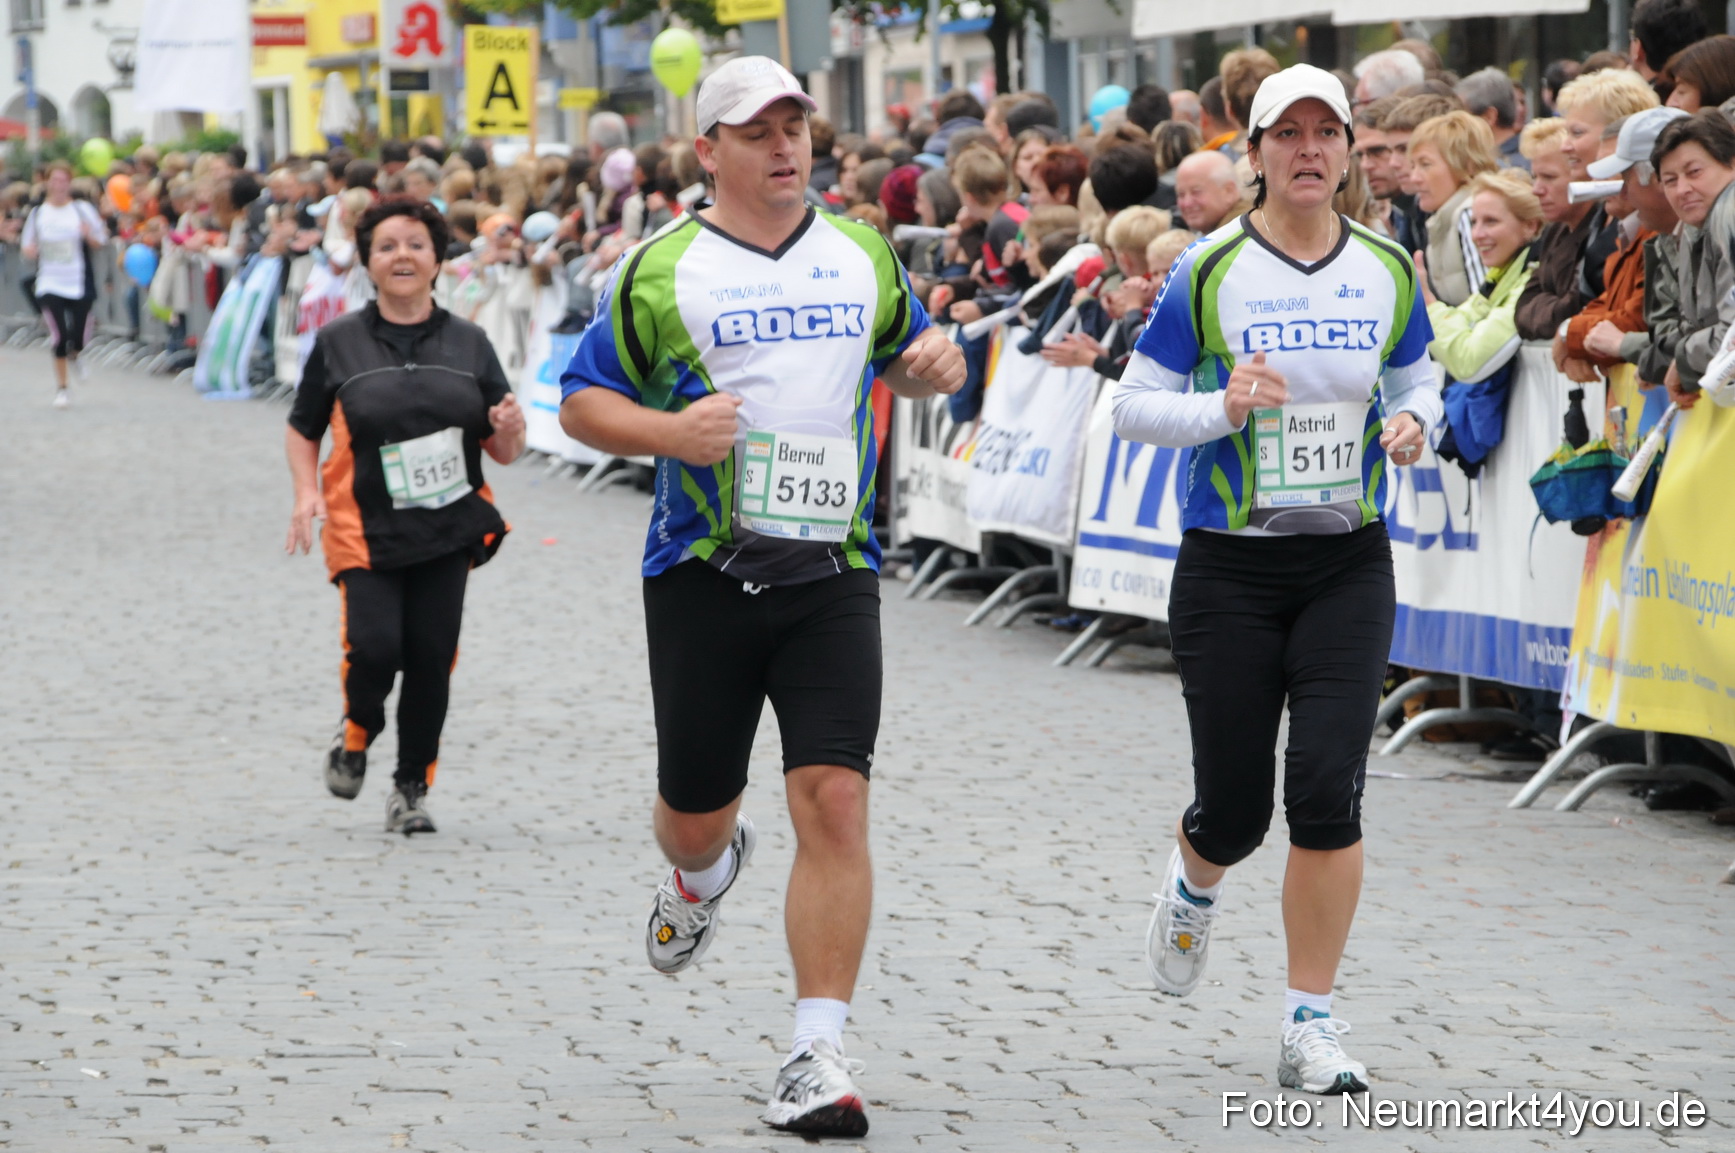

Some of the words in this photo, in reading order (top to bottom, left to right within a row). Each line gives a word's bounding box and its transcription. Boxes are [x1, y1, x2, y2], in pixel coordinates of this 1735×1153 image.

[473, 30, 528, 52] Block
[484, 62, 519, 110] A
[709, 283, 783, 302] TEAM
[1246, 297, 1308, 314] TEAM
[711, 303, 865, 347] BOCK
[1243, 319, 1379, 354] BOCK
[1288, 413, 1335, 434] Astrid
[778, 442, 825, 466] Bernd
[1260, 446, 1268, 460] S
[1292, 441, 1355, 472] 5117
[413, 455, 458, 487] 5157
[745, 469, 754, 484] S
[776, 475, 847, 508] 5133
